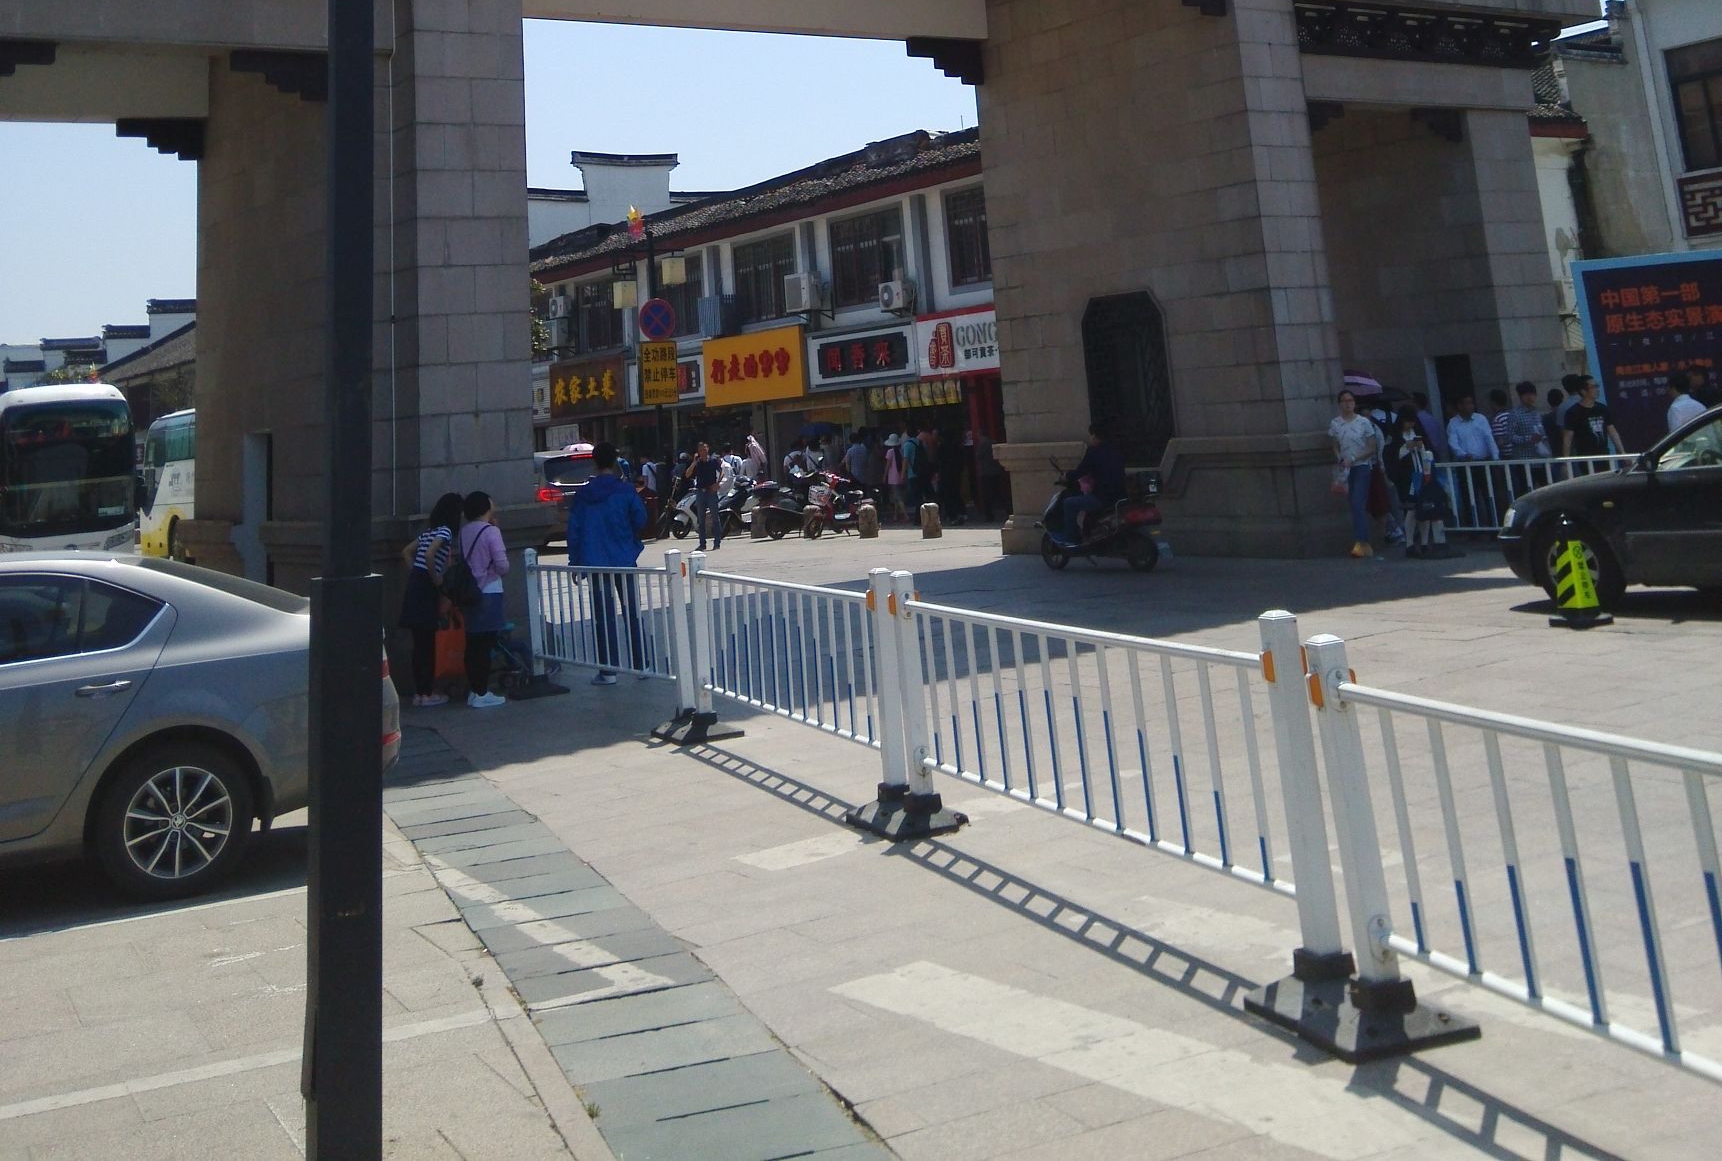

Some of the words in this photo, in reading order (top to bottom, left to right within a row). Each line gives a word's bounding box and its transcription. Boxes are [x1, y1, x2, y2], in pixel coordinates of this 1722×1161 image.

[1600, 281, 1700, 309] 中国第一部
[1606, 304, 1722, 334] 原生态实景演
[554, 369, 616, 406] 农家土菜
[644, 367, 677, 384] 禁止停车
